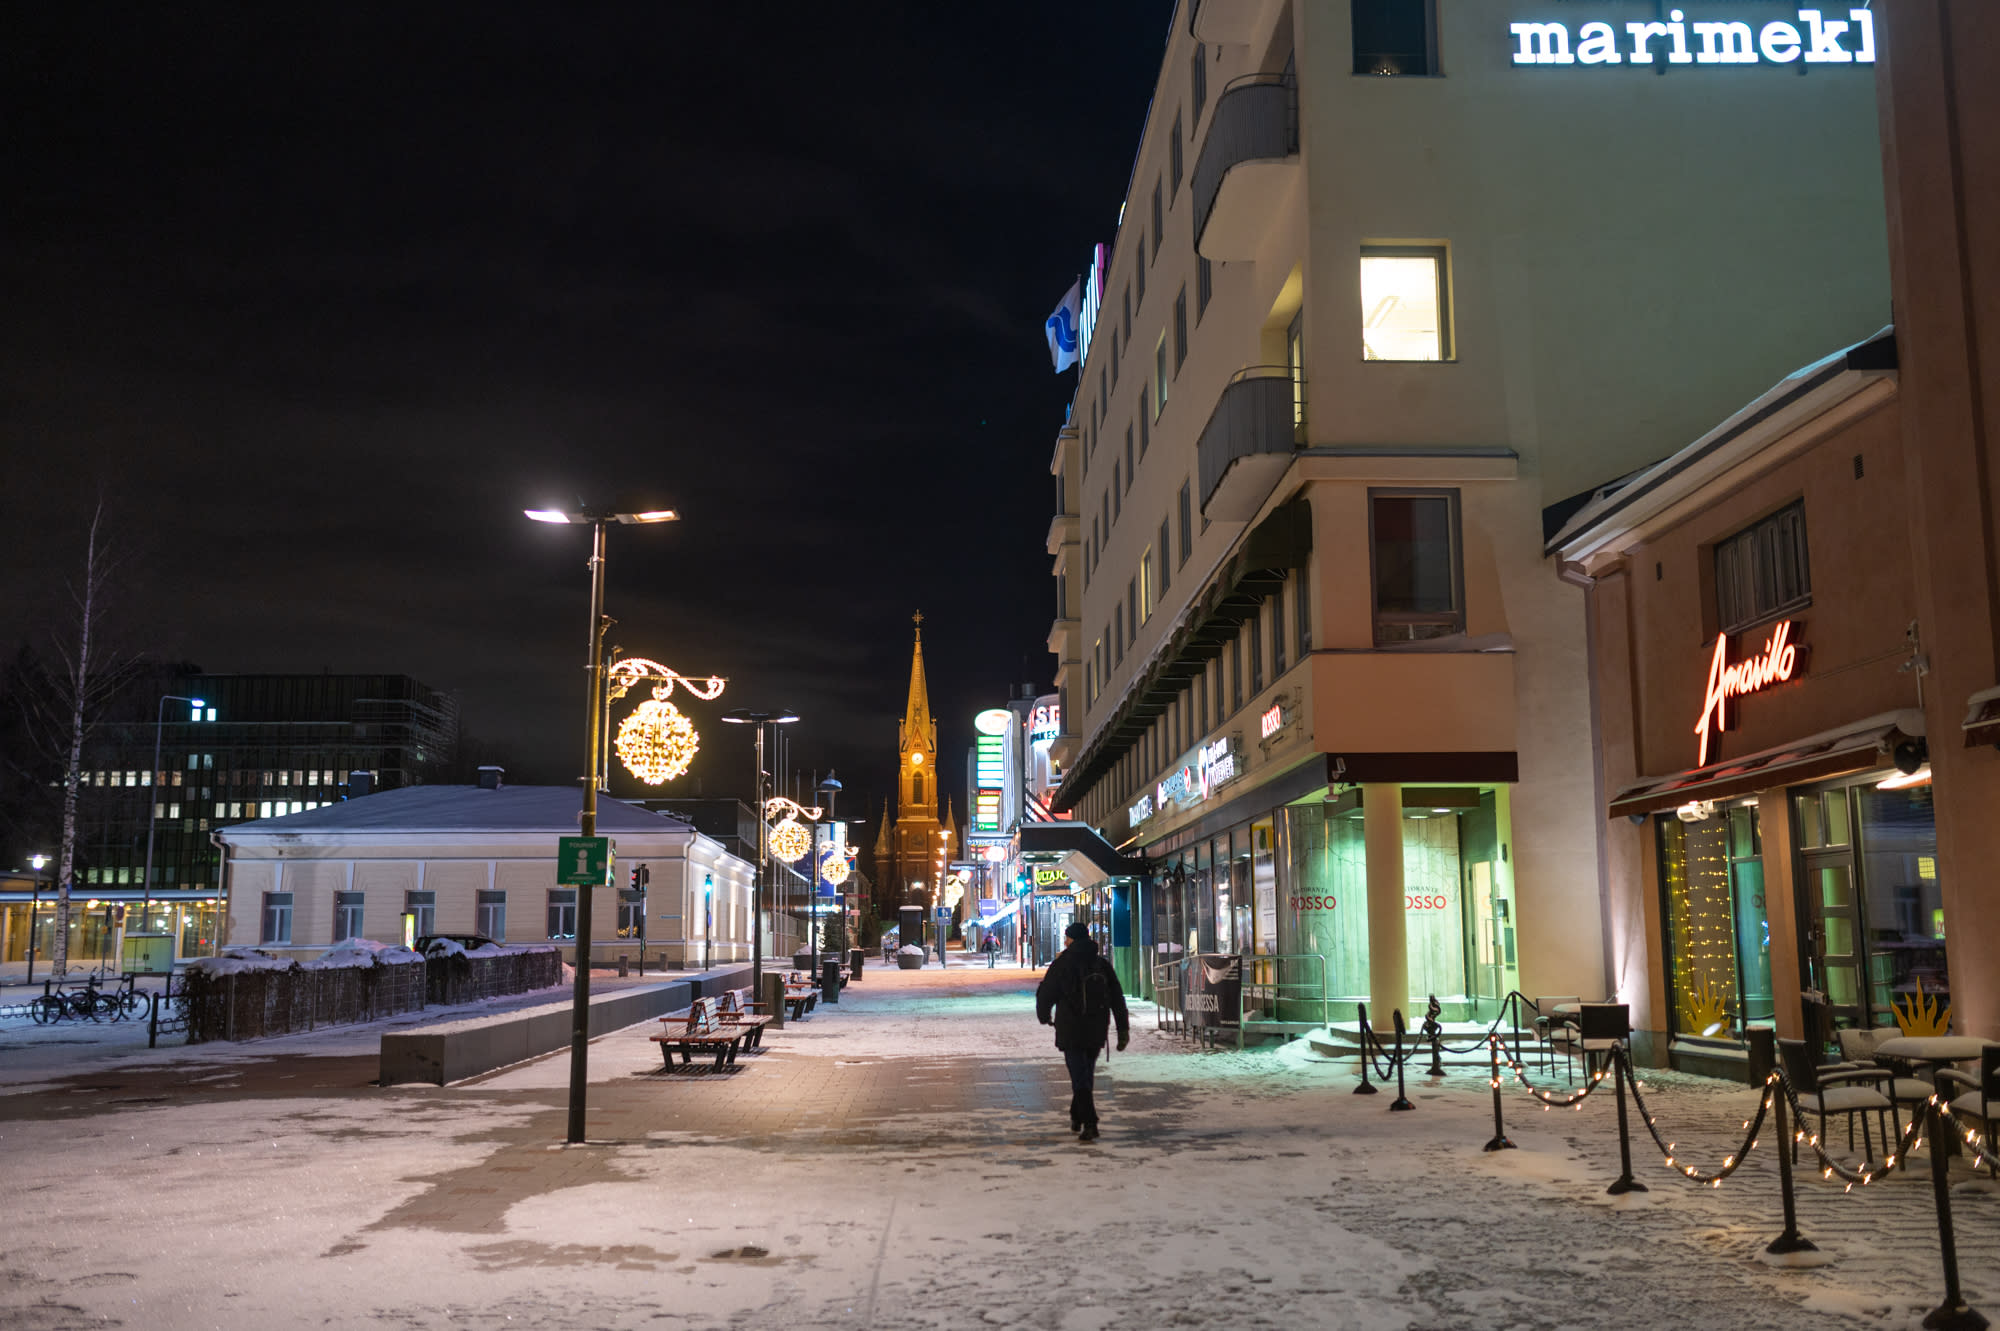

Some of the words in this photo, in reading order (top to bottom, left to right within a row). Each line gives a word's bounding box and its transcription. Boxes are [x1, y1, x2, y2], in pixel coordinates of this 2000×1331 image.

[1694, 619, 1796, 768] Amarillo
[1261, 703, 1281, 739] ROSSO
[1291, 895, 1337, 911] ROSSO
[1404, 895, 1447, 911] OSSO
